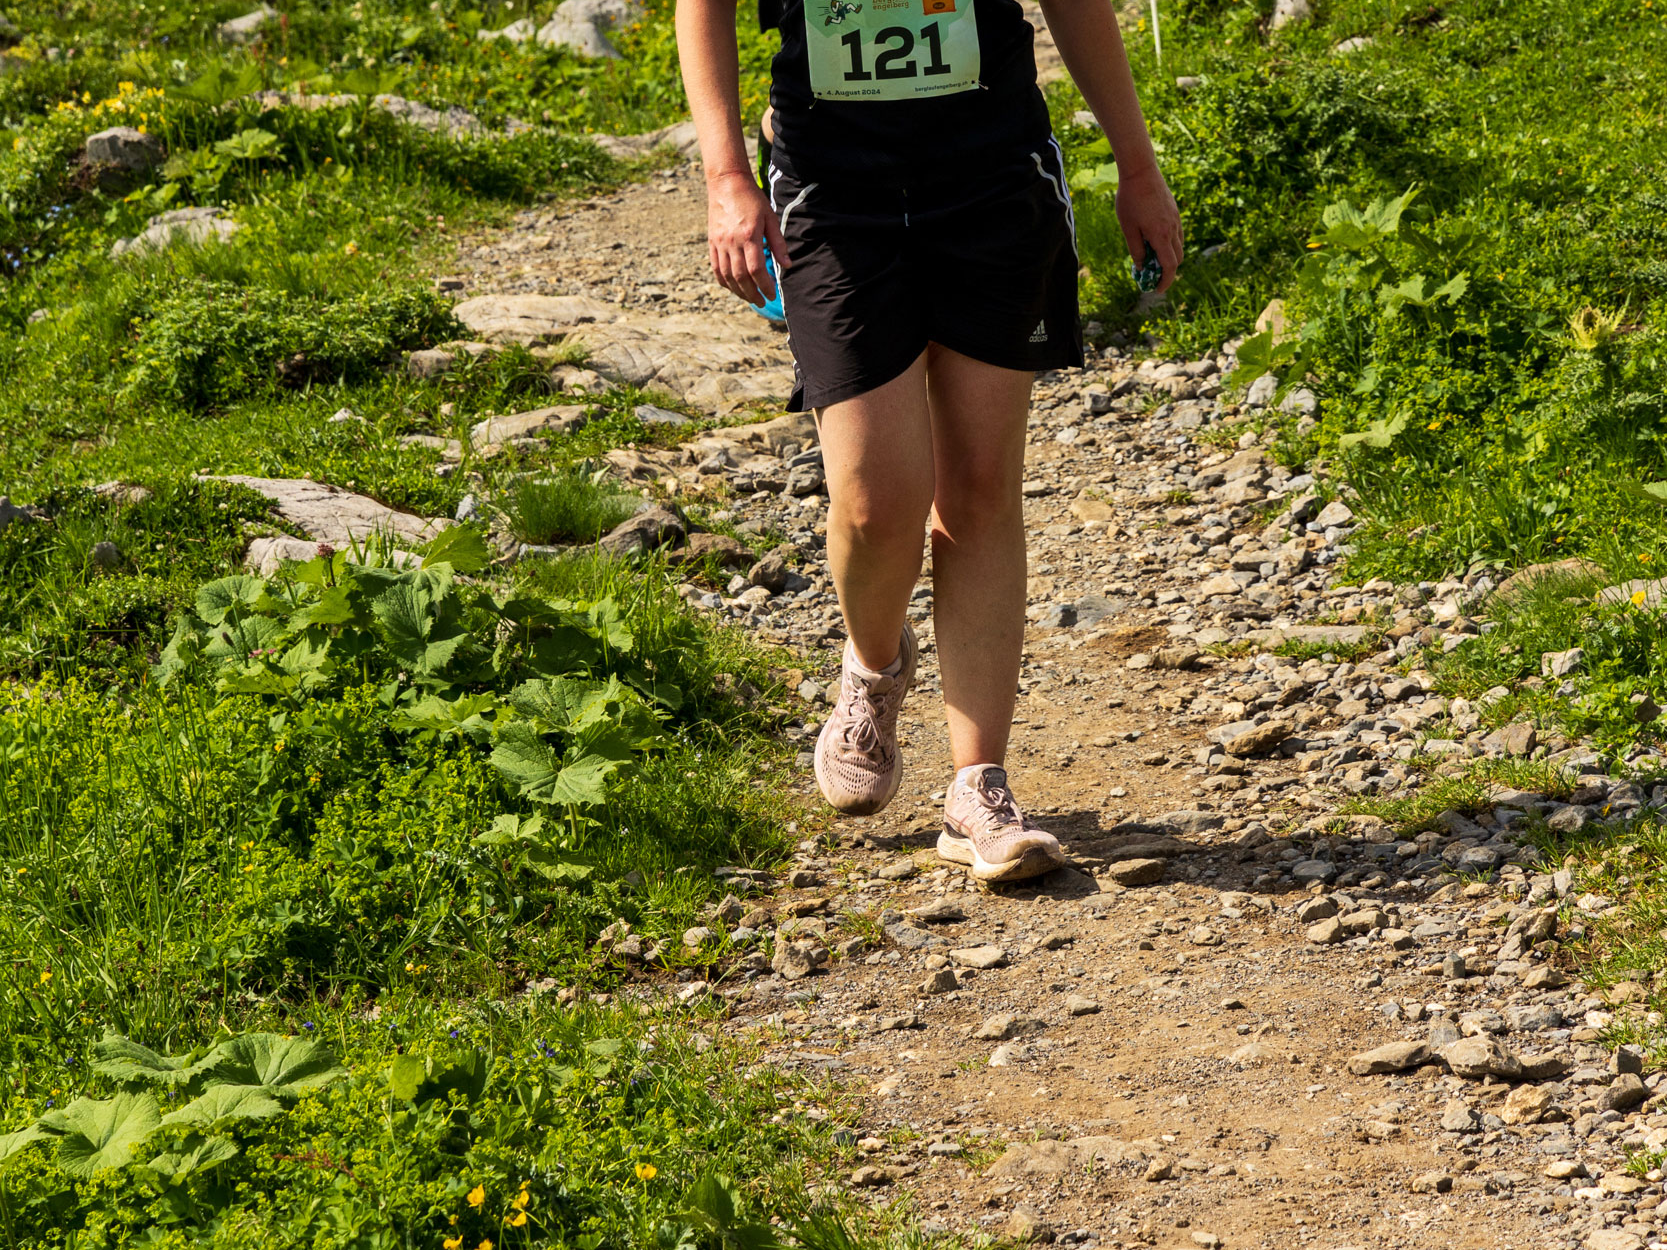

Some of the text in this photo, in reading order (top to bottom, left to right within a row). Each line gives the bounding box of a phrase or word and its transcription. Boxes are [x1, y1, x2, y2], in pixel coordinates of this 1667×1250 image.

[872, 2, 909, 11] engelberg
[841, 21, 951, 81] 121
[834, 89, 861, 97] August
